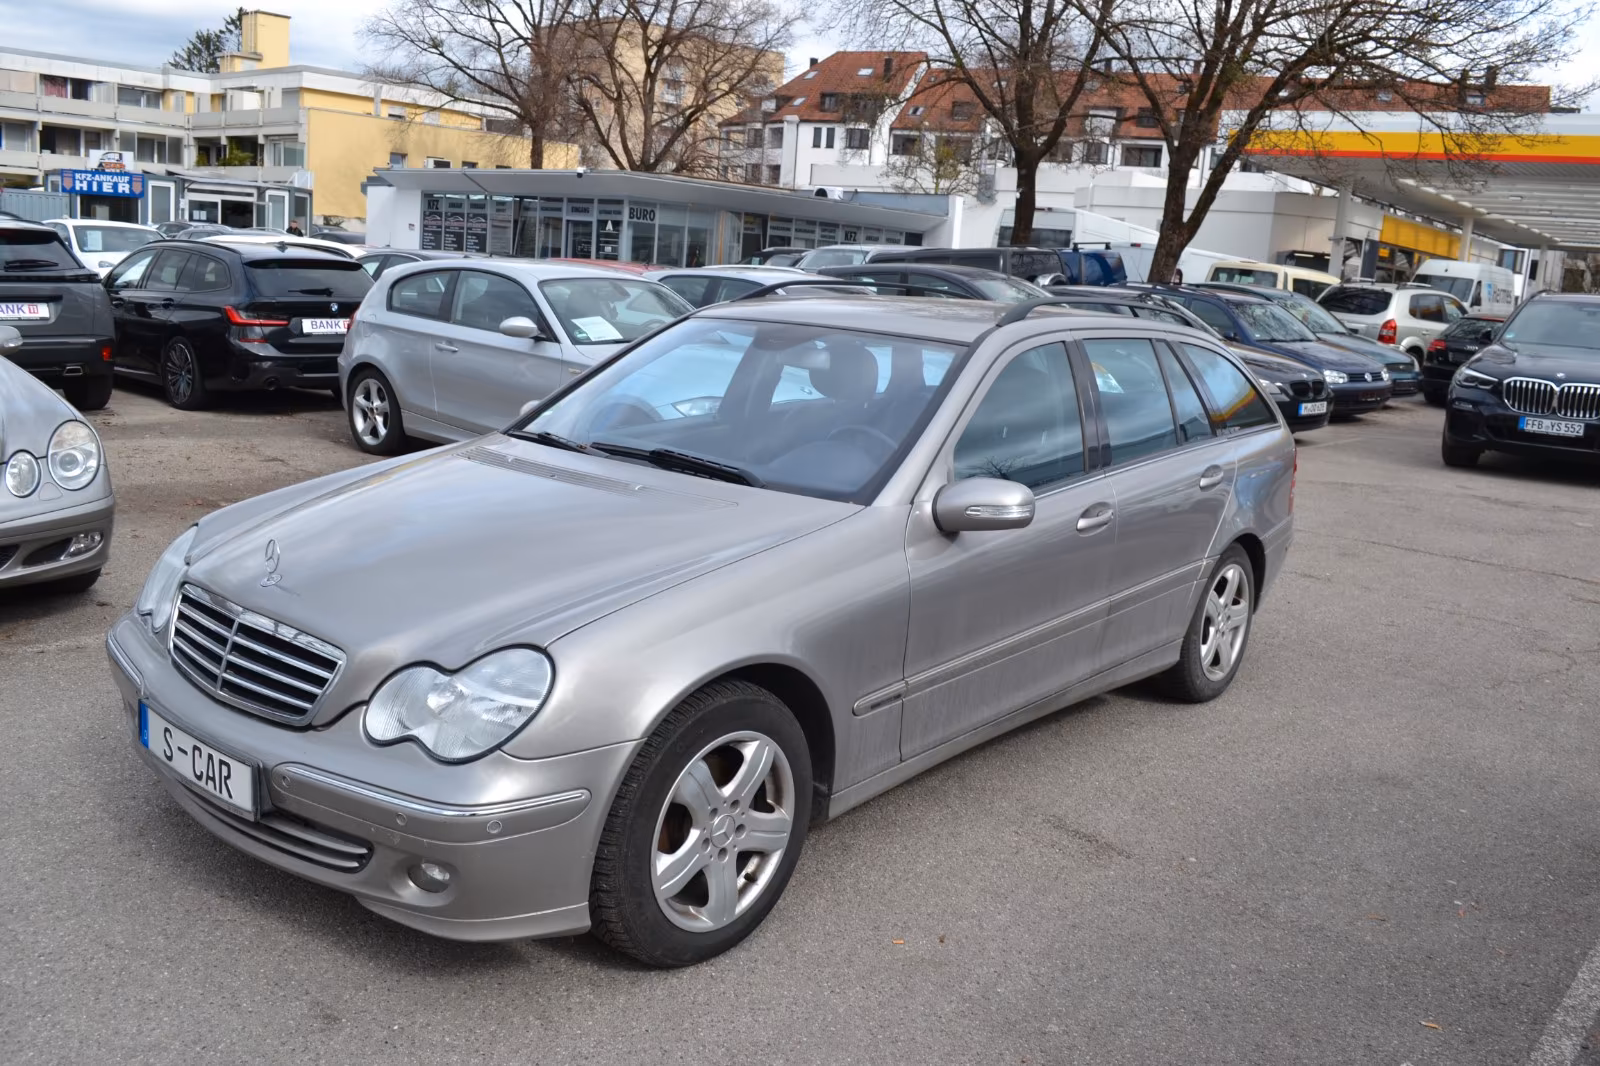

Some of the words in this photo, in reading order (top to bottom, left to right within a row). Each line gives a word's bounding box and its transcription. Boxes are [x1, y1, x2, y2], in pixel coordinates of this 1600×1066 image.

[75, 173, 130, 183] KFZ-ANKAUF
[75, 181, 130, 194] HIER
[427, 199, 439, 210] KFZ
[844, 230, 857, 242] KFZ
[311, 320, 341, 330] BANK
[1526, 418, 1544, 430] FFB
[1550, 421, 1562, 432] YS
[1564, 423, 1582, 434] 552
